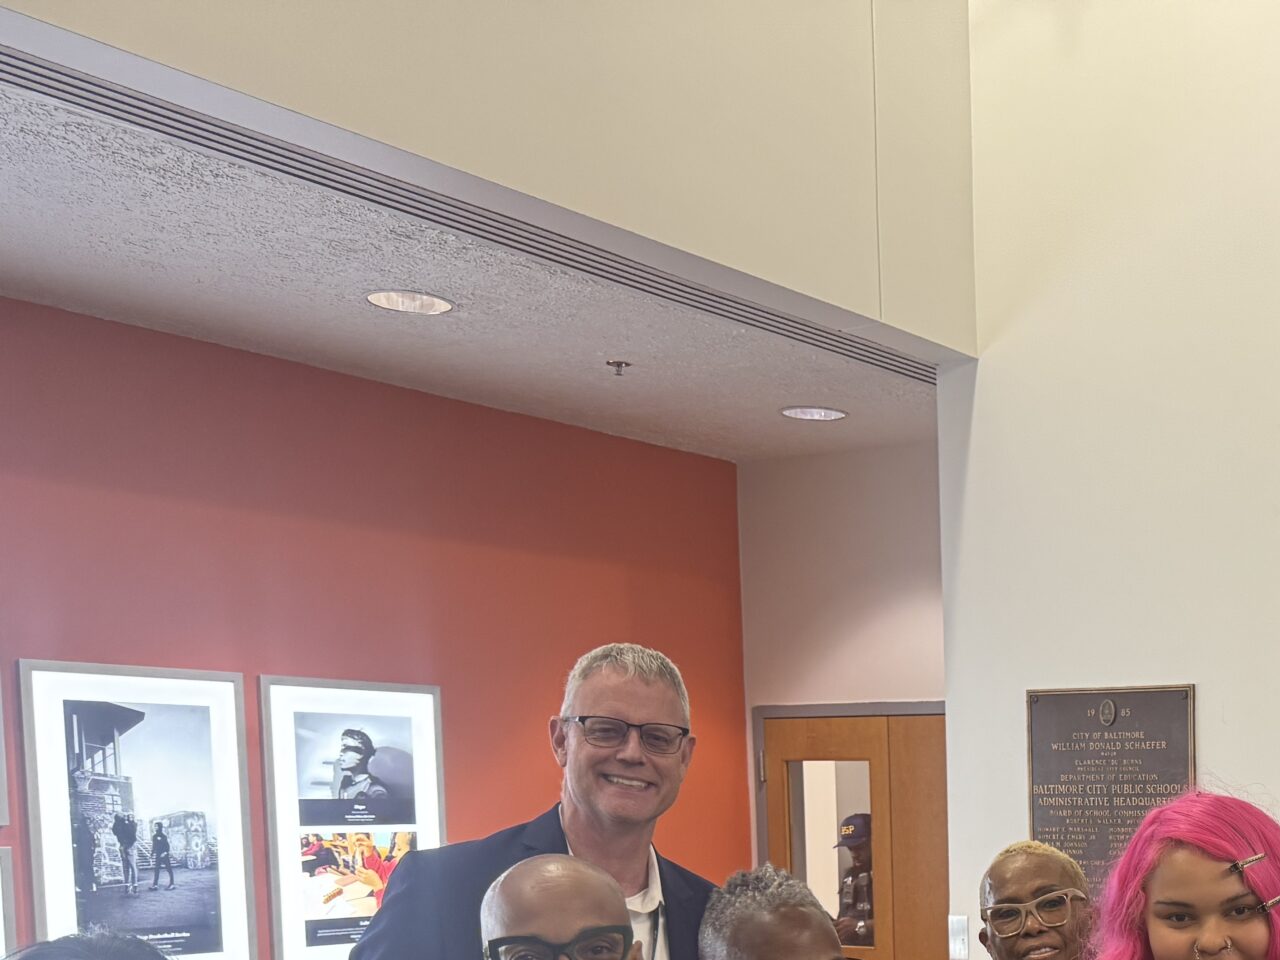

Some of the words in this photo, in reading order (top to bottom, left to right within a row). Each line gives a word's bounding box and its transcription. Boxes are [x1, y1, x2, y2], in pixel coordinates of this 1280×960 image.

[1072, 732, 1090, 740] CITY
[1092, 732, 1102, 740] OF
[1104, 731, 1145, 740] BALTIMORE
[1051, 742, 1086, 751] WILLIAM
[1089, 741, 1122, 750] DONALD
[1124, 741, 1167, 750] SCHAEFER
[1033, 784, 1085, 795] BALTIMORE
[1086, 784, 1108, 794] CITY
[1111, 784, 1144, 794] PUBLIC
[1146, 783, 1190, 794] SCHOOLS
[1038, 797, 1110, 807] ADMINISTRATIVE
[1085, 809, 1112, 817] SCHOOL
